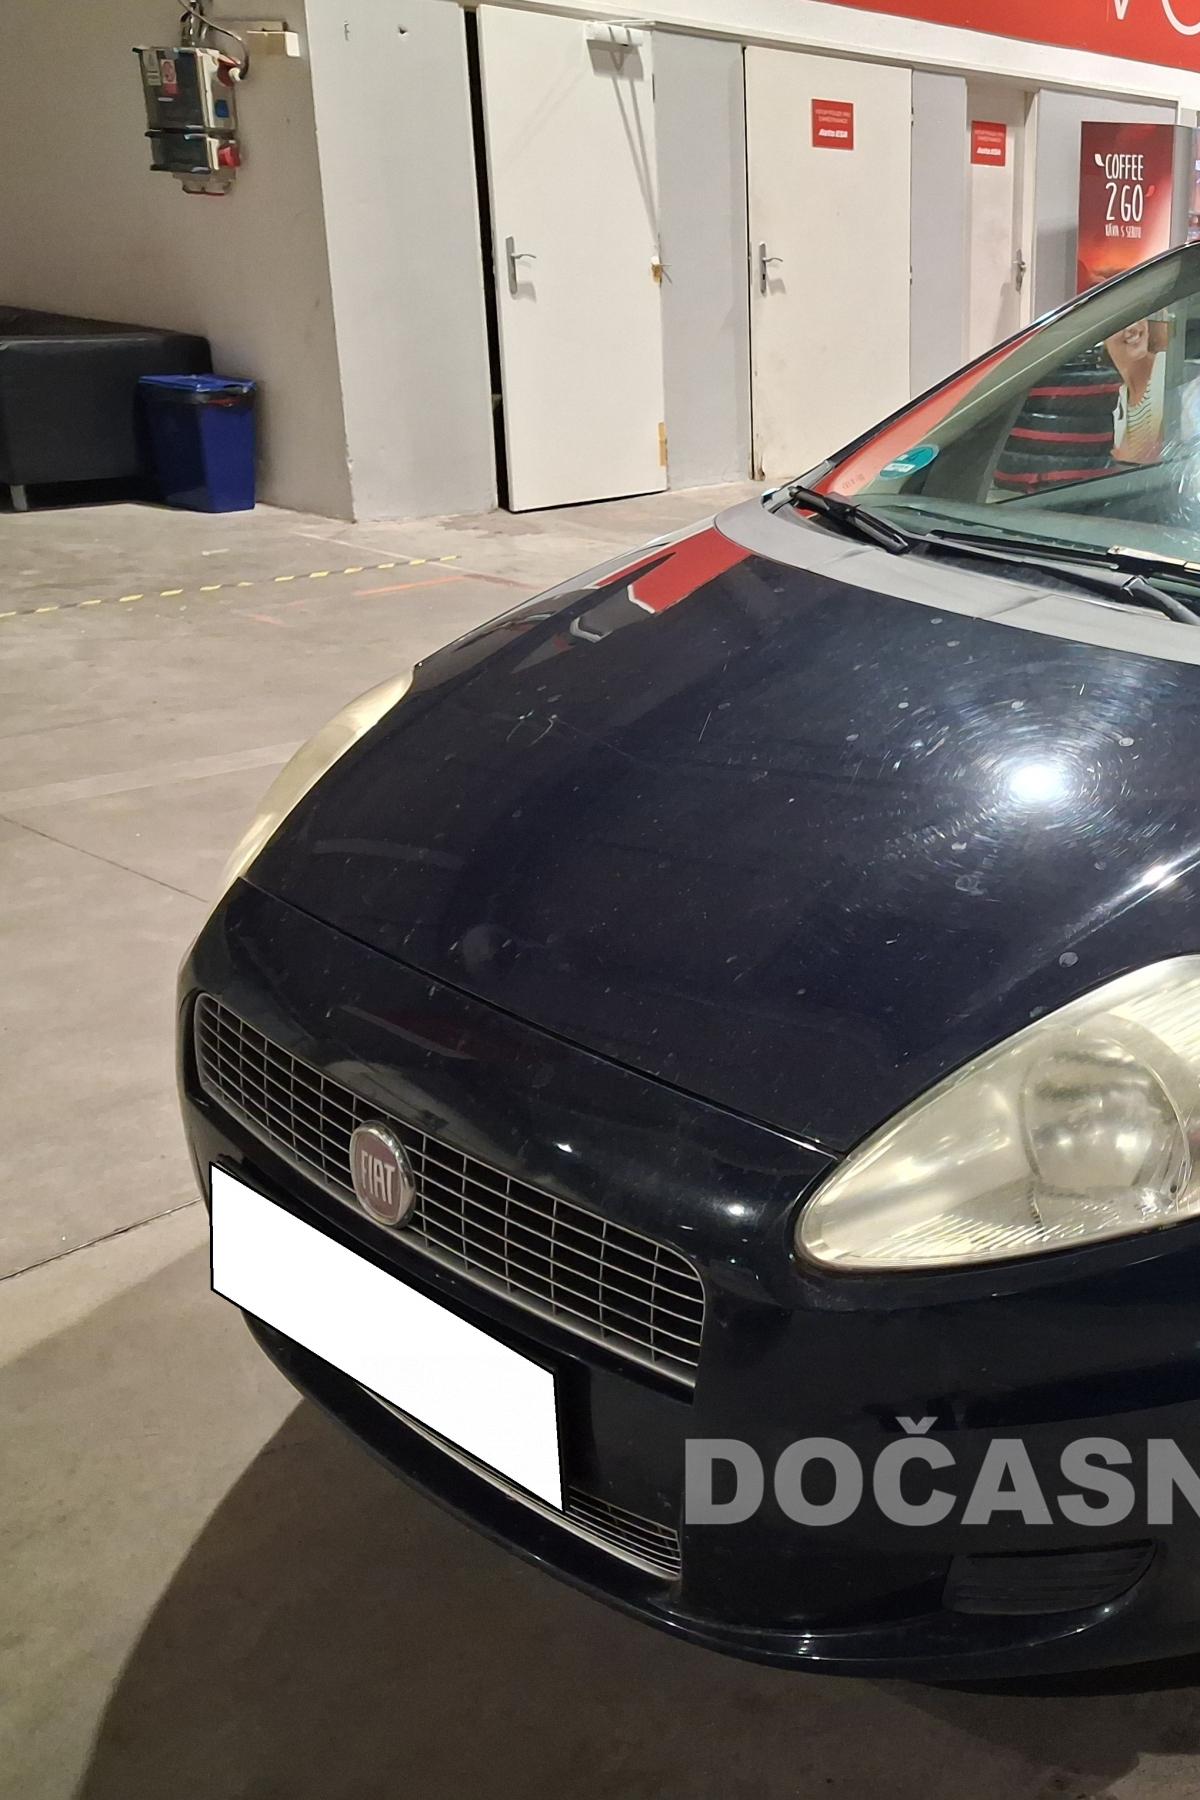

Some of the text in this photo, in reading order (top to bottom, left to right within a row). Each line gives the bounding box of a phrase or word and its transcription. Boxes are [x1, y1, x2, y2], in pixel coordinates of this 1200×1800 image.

[1105, 153, 1144, 181] COFFEE
[1105, 182, 1144, 222] 2 GO
[361, 1150, 396, 1205] FIAT
